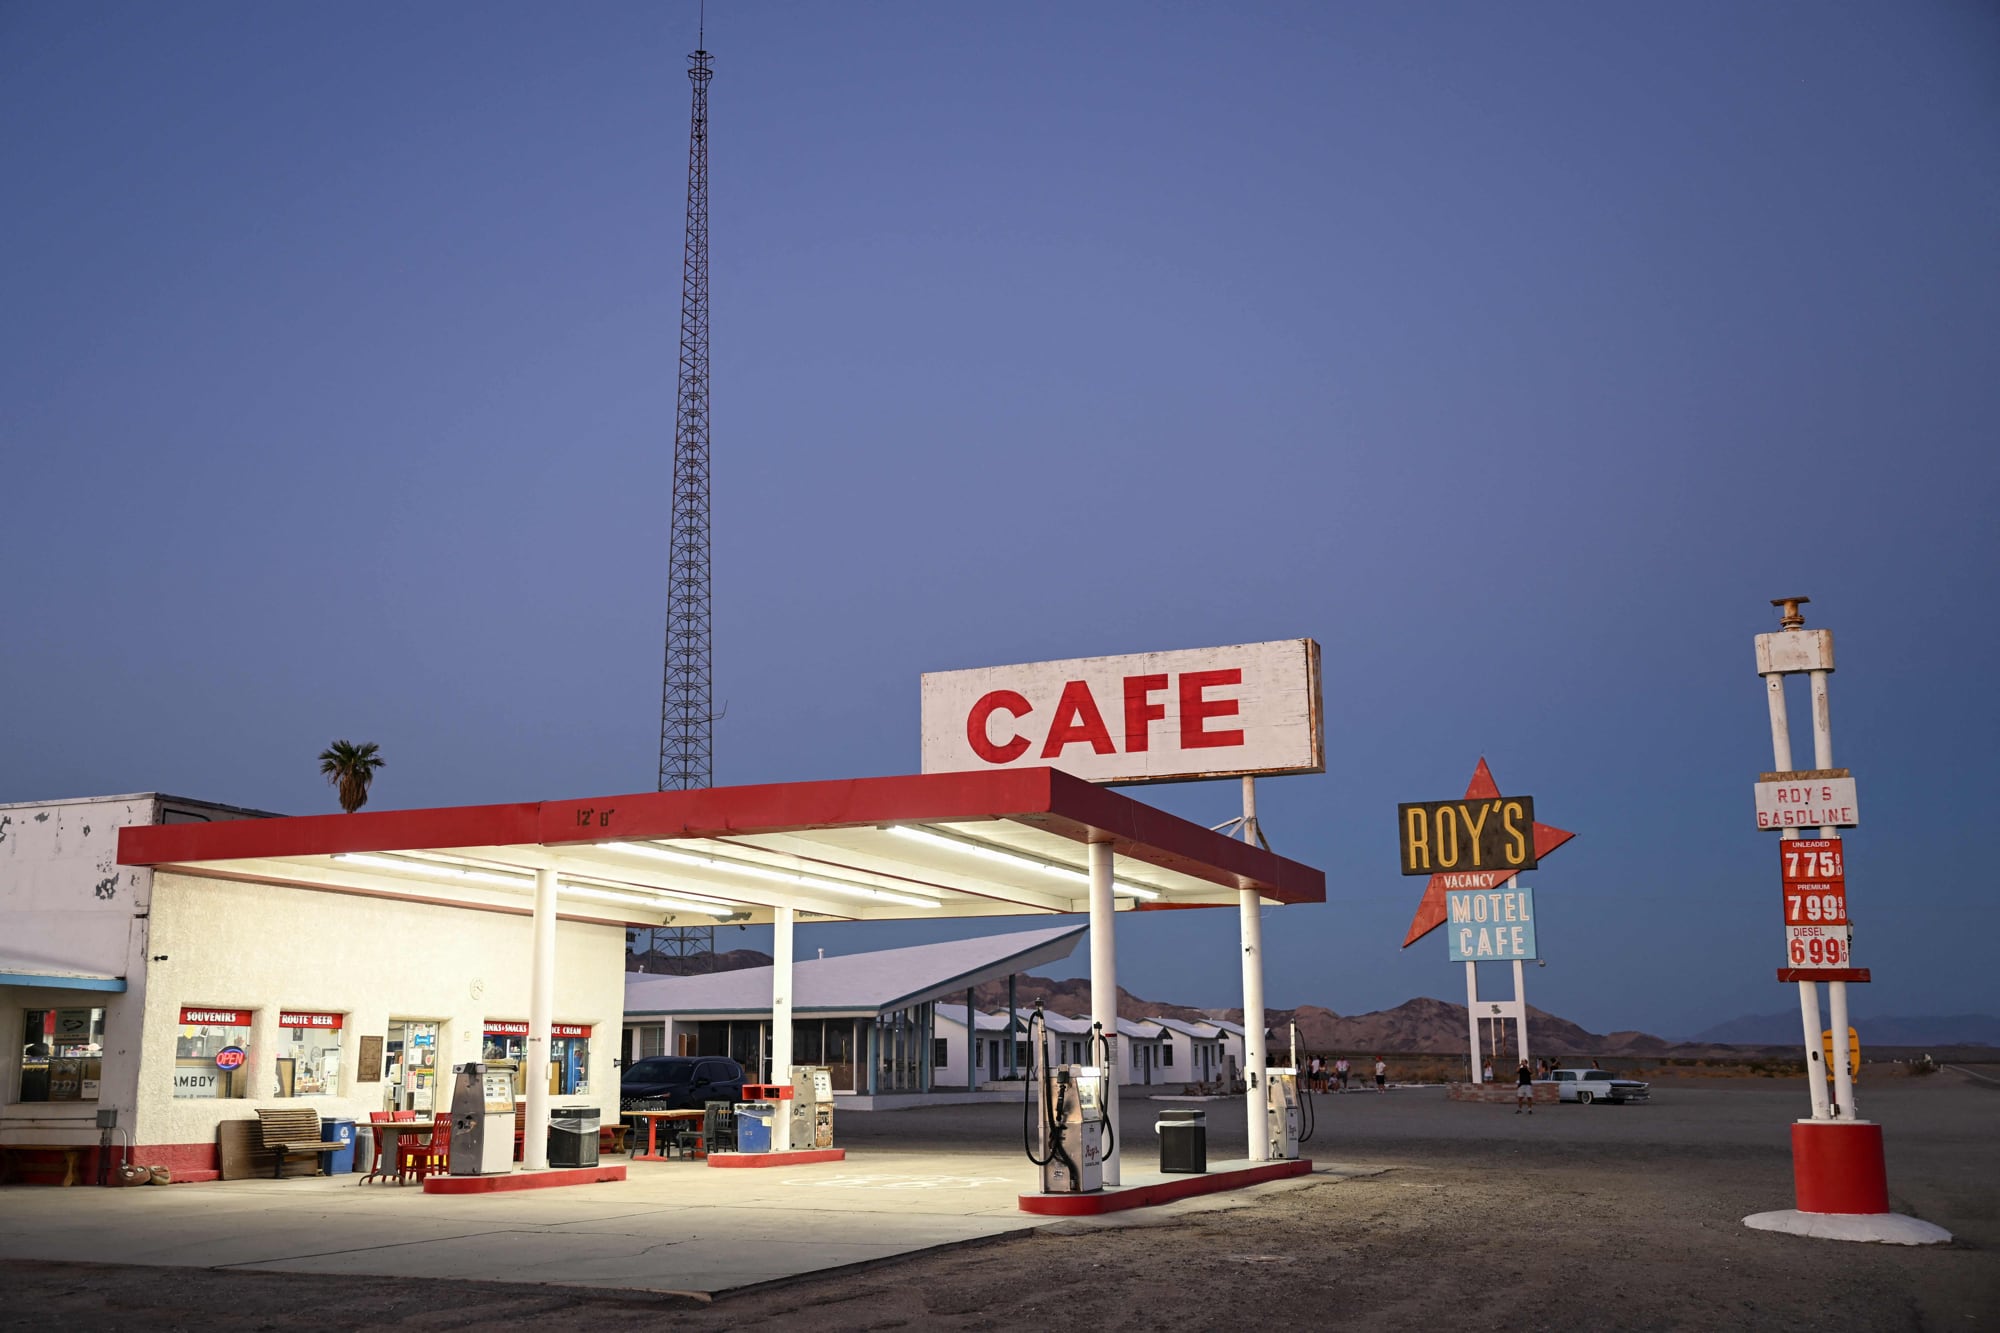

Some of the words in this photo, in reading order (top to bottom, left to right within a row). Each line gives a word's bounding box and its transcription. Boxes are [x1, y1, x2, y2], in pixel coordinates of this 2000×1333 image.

[967, 668, 1245, 764] CAFE
[1758, 807, 1852, 827] GASOLINE
[1407, 800, 1526, 869] ROY'S
[1792, 841, 1830, 849] UNLEADED
[1785, 851, 1835, 878] 775
[1443, 873, 1495, 888] VACANCY
[1797, 883, 1830, 891] PREMIUM
[1451, 893, 1530, 923] MOTEL
[1787, 894, 1838, 921] 799
[1793, 927, 1825, 937] DIESEL
[1460, 926, 1525, 956] CAFE
[1790, 937, 1841, 964] 699
[186, 1011, 237, 1023] SOUVENIRS
[312, 1015, 333, 1025] BEER
[562, 1026, 582, 1035] CREAM
[216, 1052, 244, 1065] OPEN
